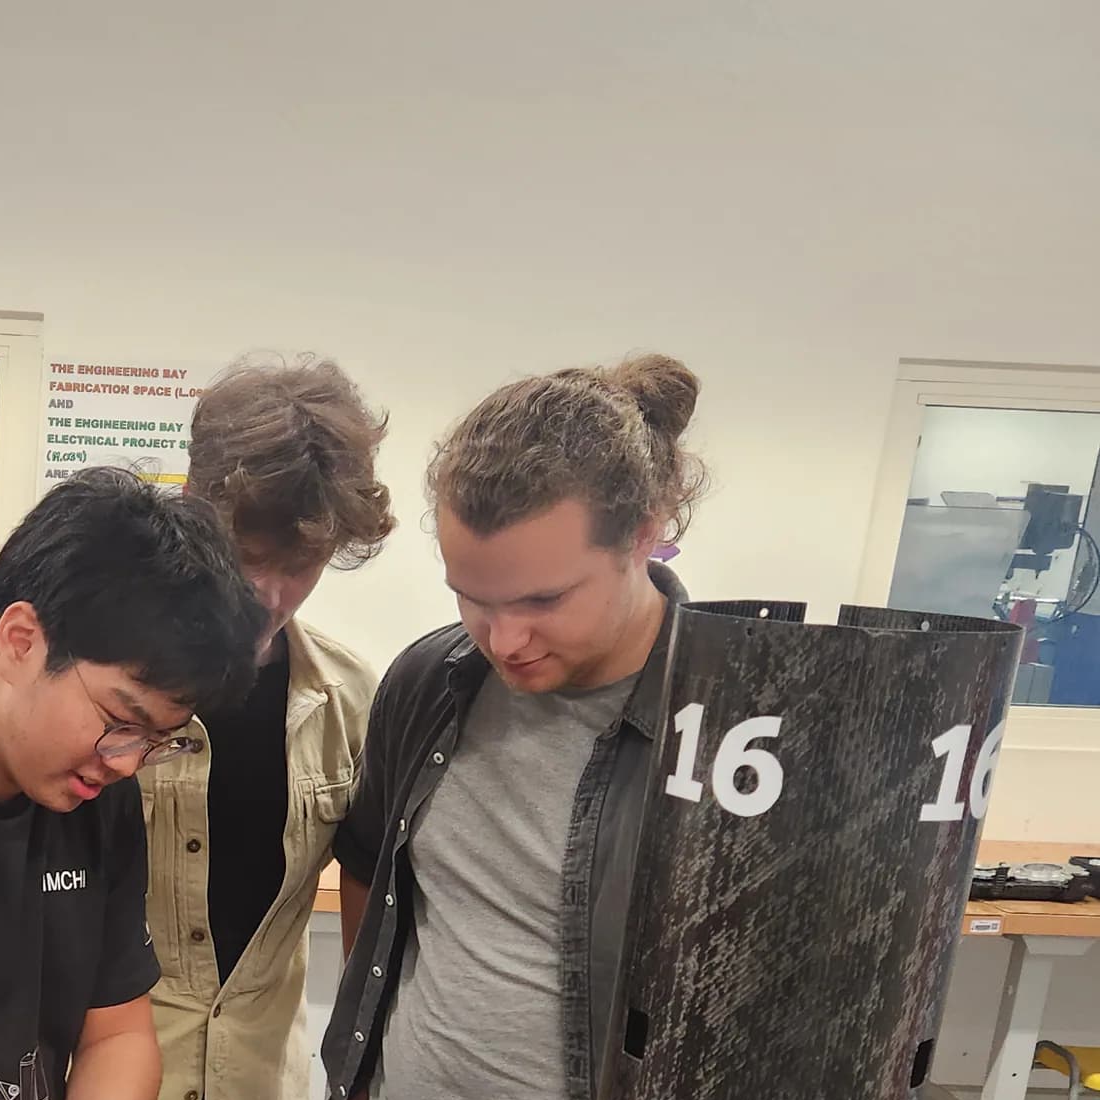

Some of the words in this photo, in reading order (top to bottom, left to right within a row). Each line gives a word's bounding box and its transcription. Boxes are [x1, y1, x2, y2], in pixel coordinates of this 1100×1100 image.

[50, 363, 75, 374] THE
[77, 364, 160, 378] ENGINEERING
[163, 368, 188, 380] BAY
[49, 381, 130, 395] FABRICATION
[133, 385, 172, 397] SPACE
[48, 398, 74, 410] AND
[47, 416, 72, 428] THE
[74, 418, 156, 432] ENGINEERING
[159, 421, 183, 433] BAY
[47, 434, 119, 447] ELECTRICAL
[122, 438, 176, 449] PROJECT
[45, 468, 70, 480] ARE
[664, 701, 784, 817] 16
[918, 718, 1006, 822] 16
